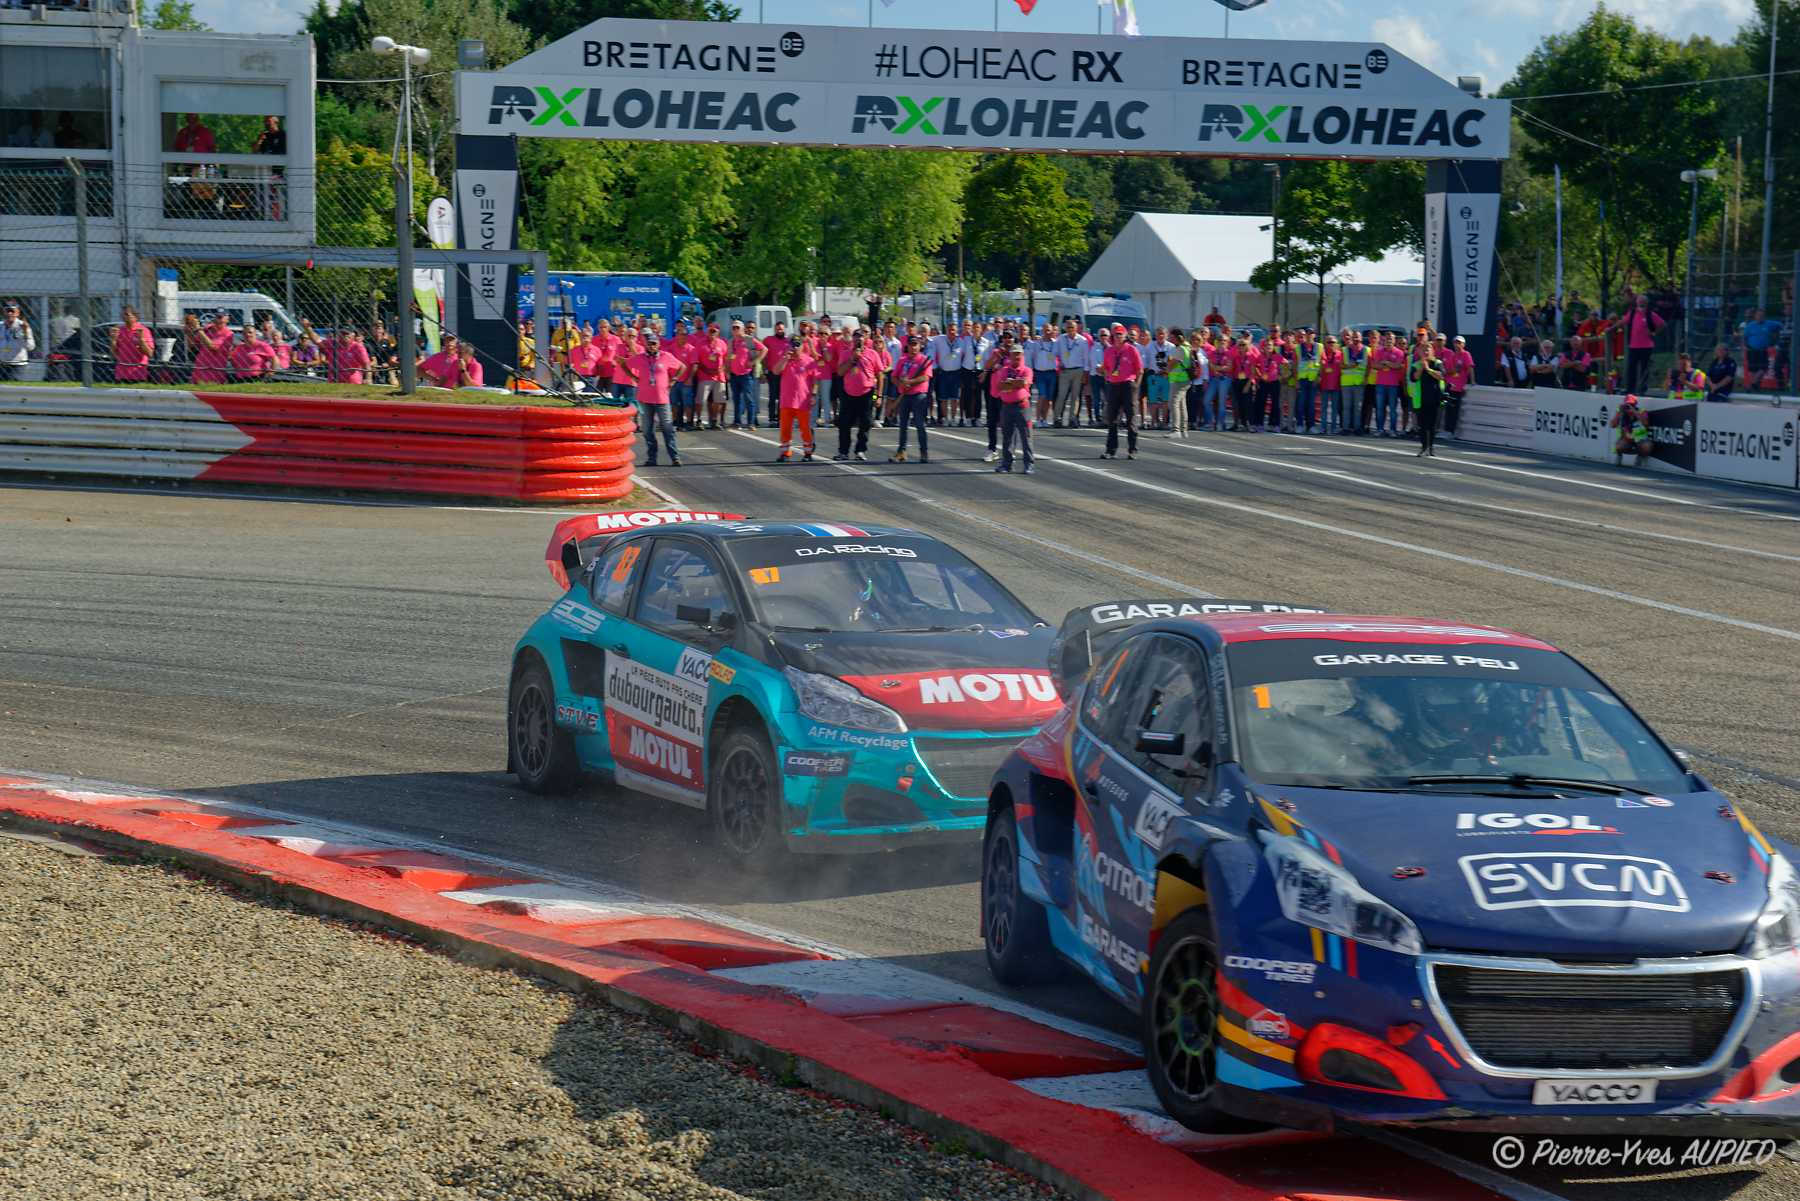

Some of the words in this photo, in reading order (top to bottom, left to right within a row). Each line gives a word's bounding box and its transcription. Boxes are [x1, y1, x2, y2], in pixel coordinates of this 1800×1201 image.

[583, 40, 776, 73] BRETAGNE
[875, 44, 1057, 82] #LOHEAC
[1072, 50, 1123, 83] RX
[1182, 59, 1362, 89] BRETAGNE
[480, 199, 496, 298] BREAGNE
[1465, 220, 1480, 315] BRETAGNE
[1535, 410, 1599, 440] BRETAGNE
[1648, 425, 1685, 445] ETAGNE
[1700, 429, 1781, 461] BRETAGNE
[1313, 655, 1449, 666] GARAGE
[1452, 655, 1520, 670] PEU
[609, 667, 705, 736] dubourgauto.
[919, 673, 1057, 703] MOTU
[629, 724, 692, 779] MOTUL
[808, 726, 837, 740] AFM
[840, 731, 909, 751] Recyclage
[1456, 812, 1602, 831] IGOL
[1095, 852, 1157, 914] CITROE
[1479, 862, 1670, 897] SVCM
[1224, 955, 1317, 975] COOPER
[1264, 970, 1314, 984] TIRES
[1551, 1084, 1642, 1102] YACCO
